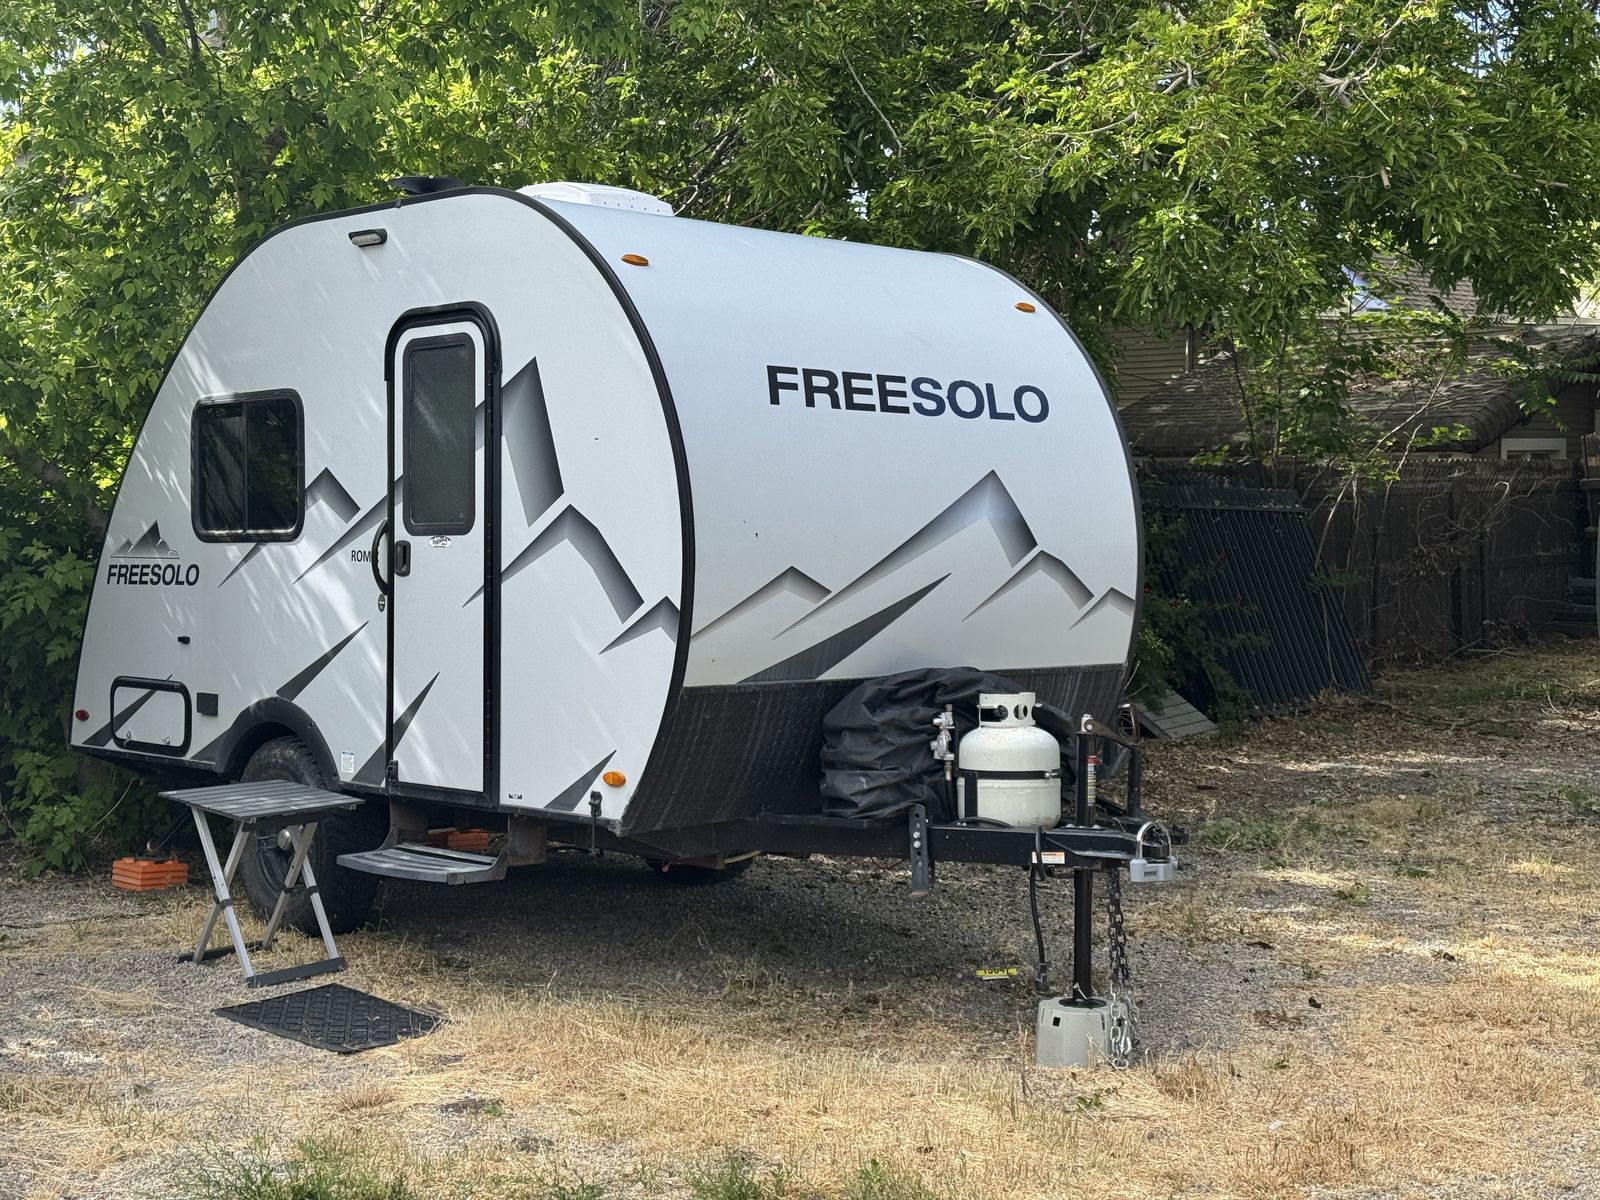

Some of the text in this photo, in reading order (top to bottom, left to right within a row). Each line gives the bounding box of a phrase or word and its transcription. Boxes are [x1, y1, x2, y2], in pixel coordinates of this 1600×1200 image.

[766, 365, 1049, 423] FREESOLO
[351, 550, 372, 562] ROM
[106, 563, 199, 586] FREESOLO
